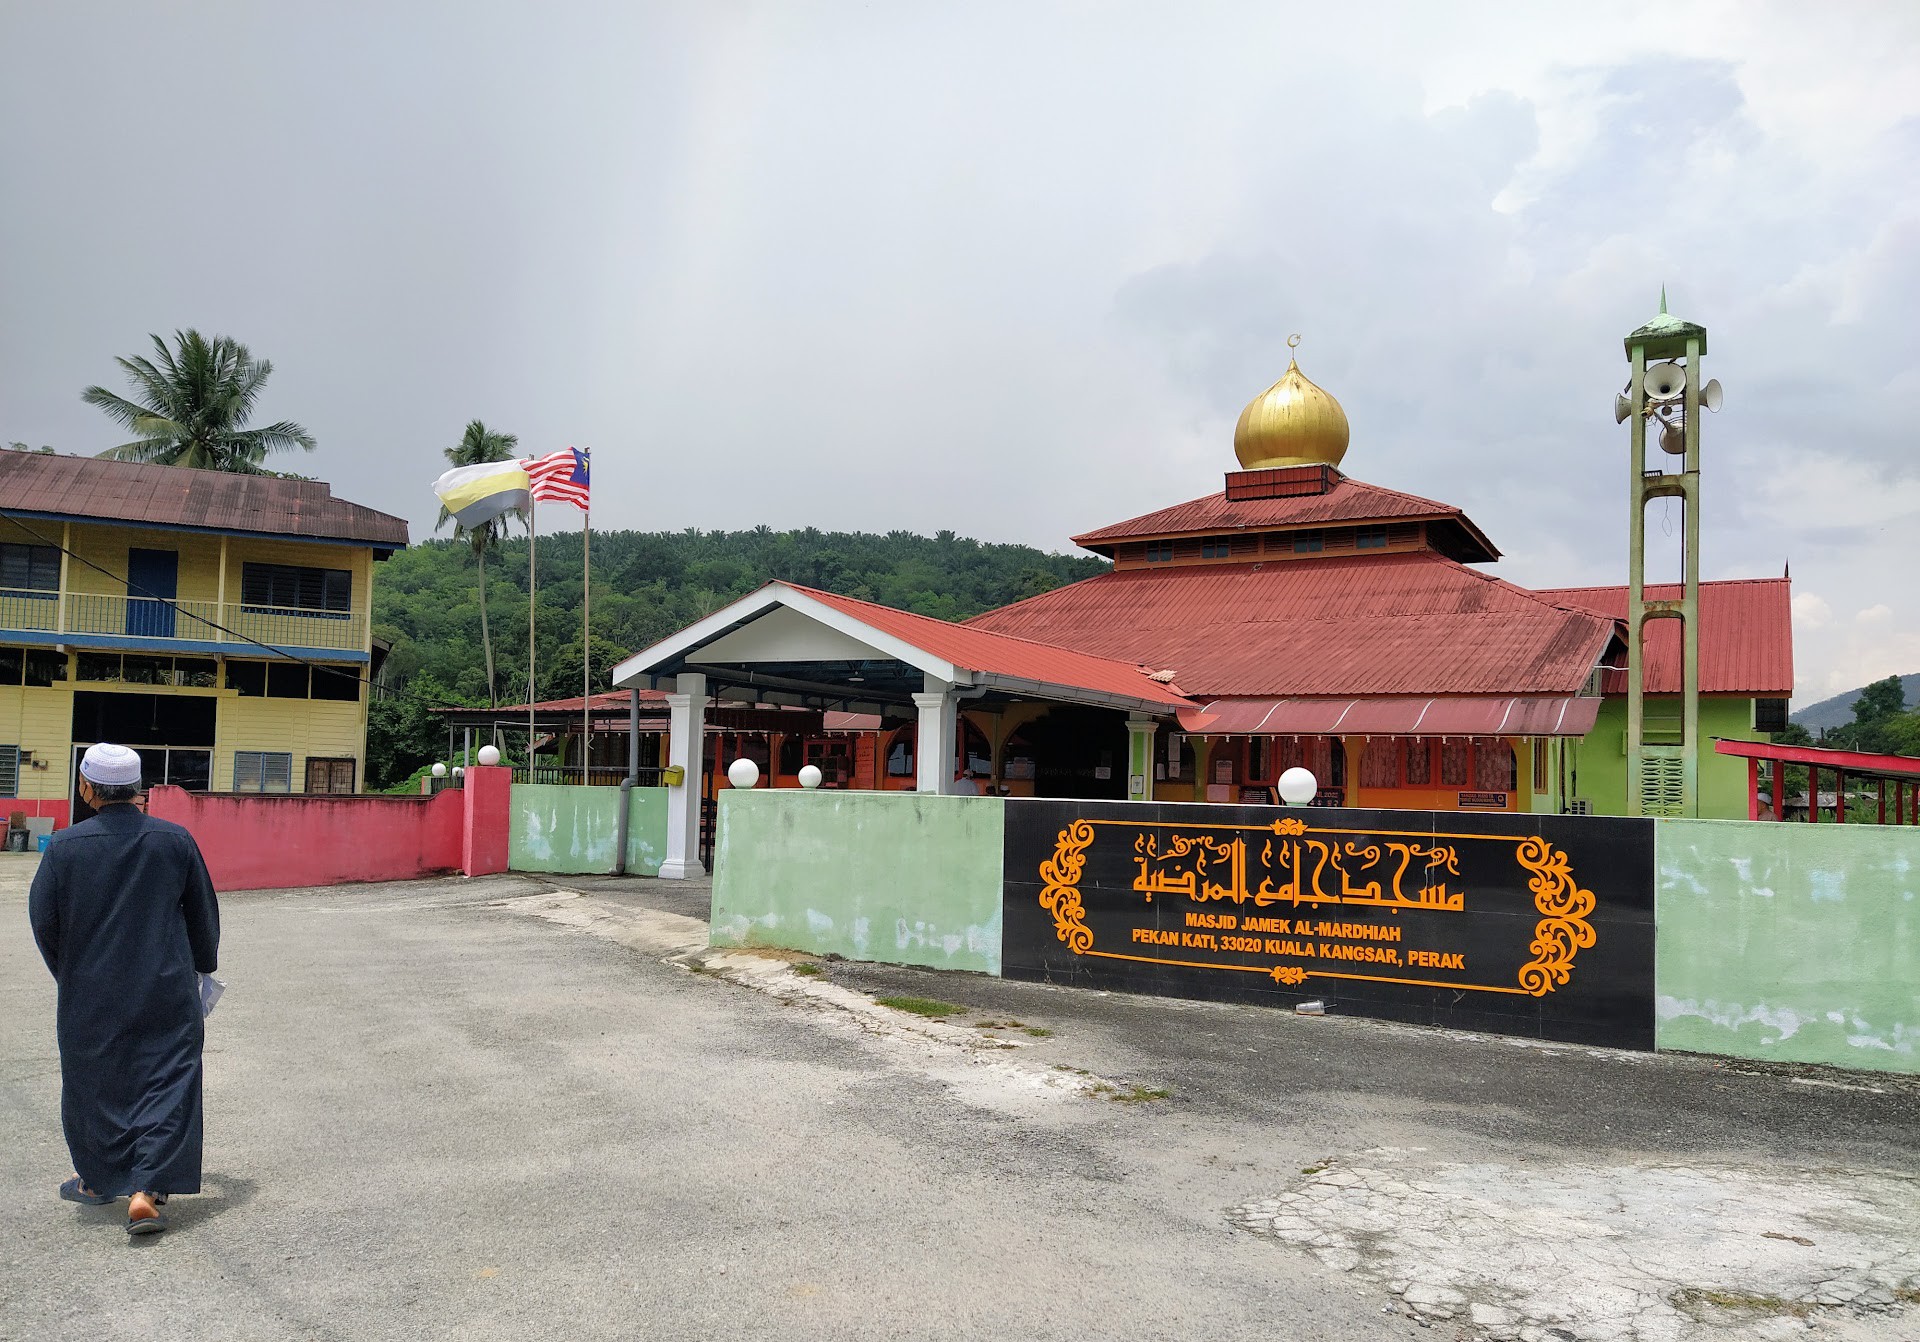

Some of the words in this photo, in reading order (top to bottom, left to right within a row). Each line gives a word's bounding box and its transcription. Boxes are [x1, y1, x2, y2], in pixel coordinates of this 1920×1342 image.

[1185, 912, 1237, 930] MASJID
[1240, 917, 1291, 934] JAMEK
[1293, 920, 1401, 942] AL-MARDHIAH
[1132, 928, 1180, 946] PEKAN
[1181, 932, 1219, 952] KATI,
[1220, 935, 1262, 953] 33020
[1264, 939, 1316, 957] KUALA
[1319, 943, 1403, 967] KANGSAR,
[1407, 950, 1465, 970] PERAK
